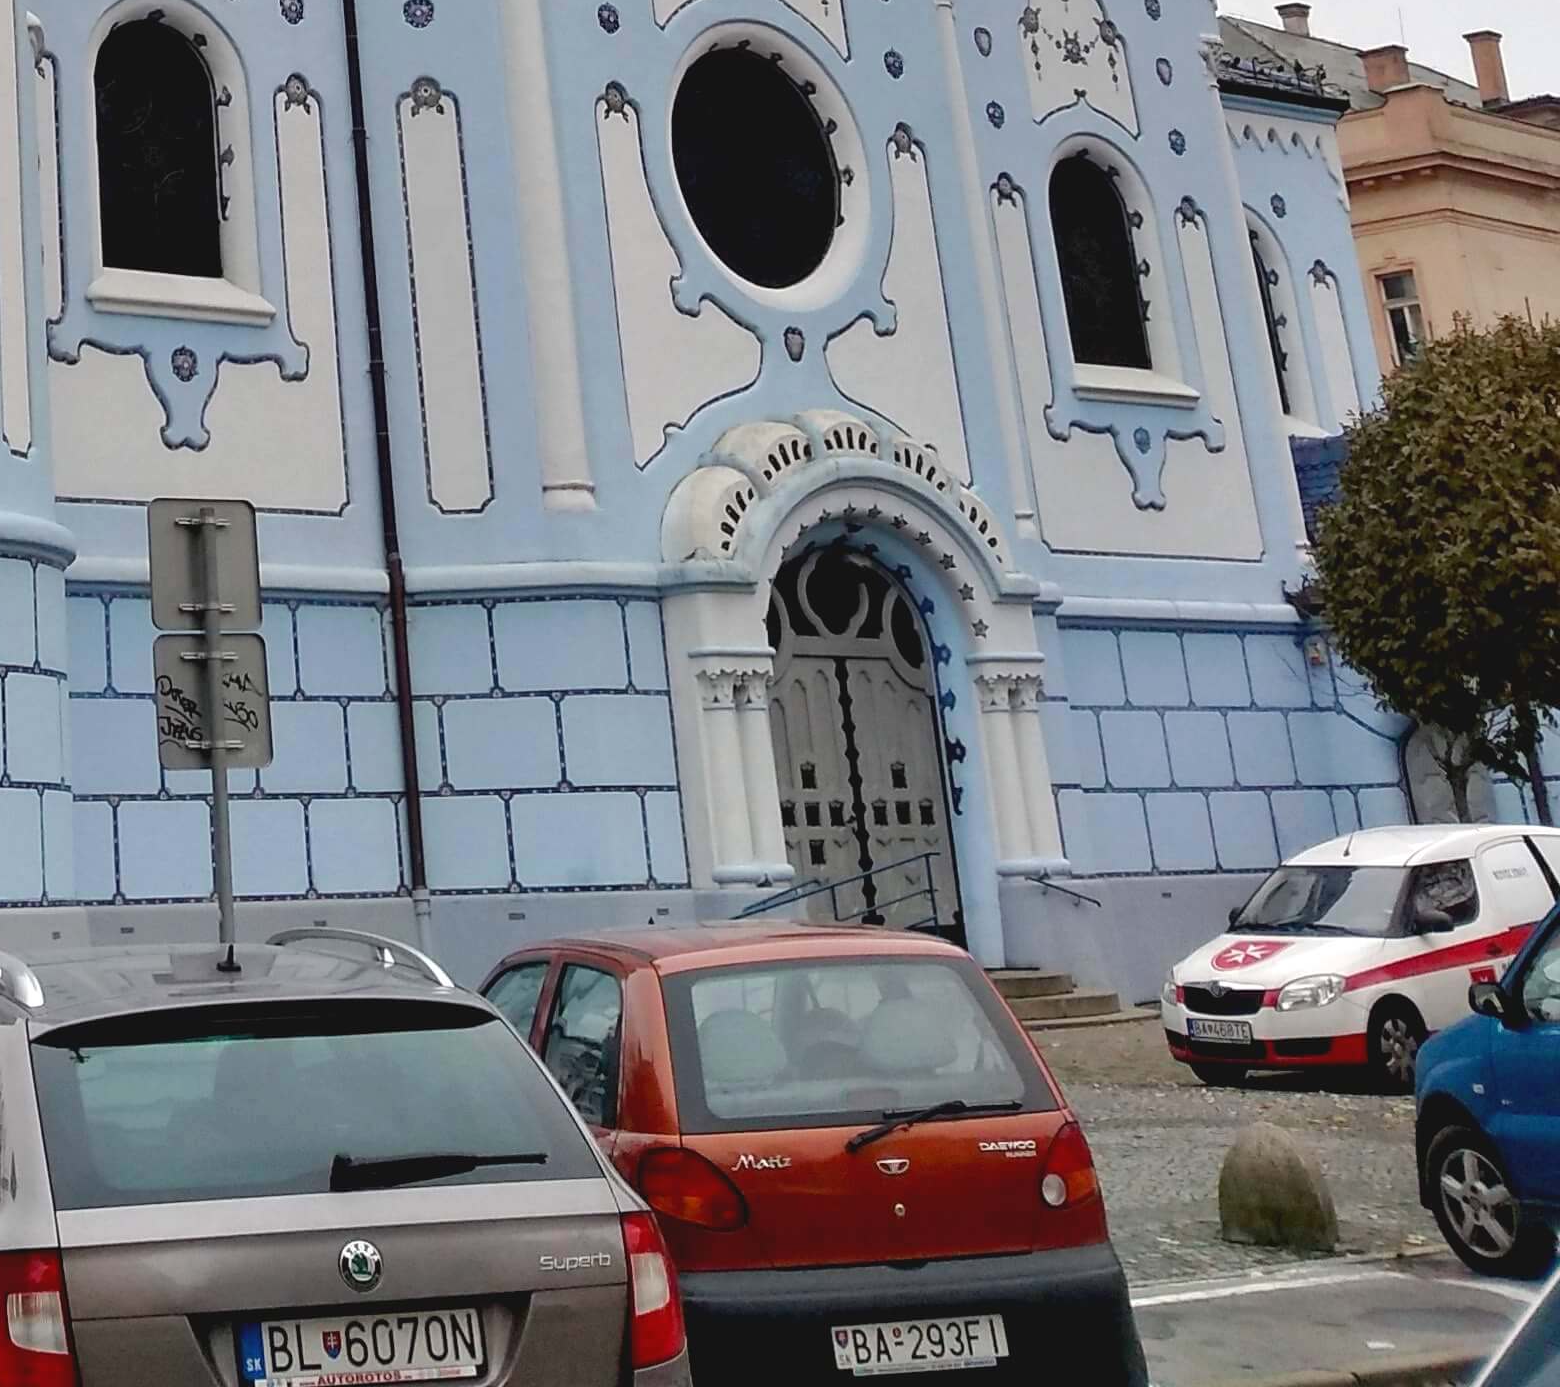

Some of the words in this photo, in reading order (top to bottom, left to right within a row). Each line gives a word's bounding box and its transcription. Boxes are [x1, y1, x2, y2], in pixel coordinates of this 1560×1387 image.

[731, 1154, 792, 1171] Matiz
[540, 1252, 611, 1271] Superb
[268, 1323, 322, 1373] BL
[246, 1358, 262, 1372] SK
